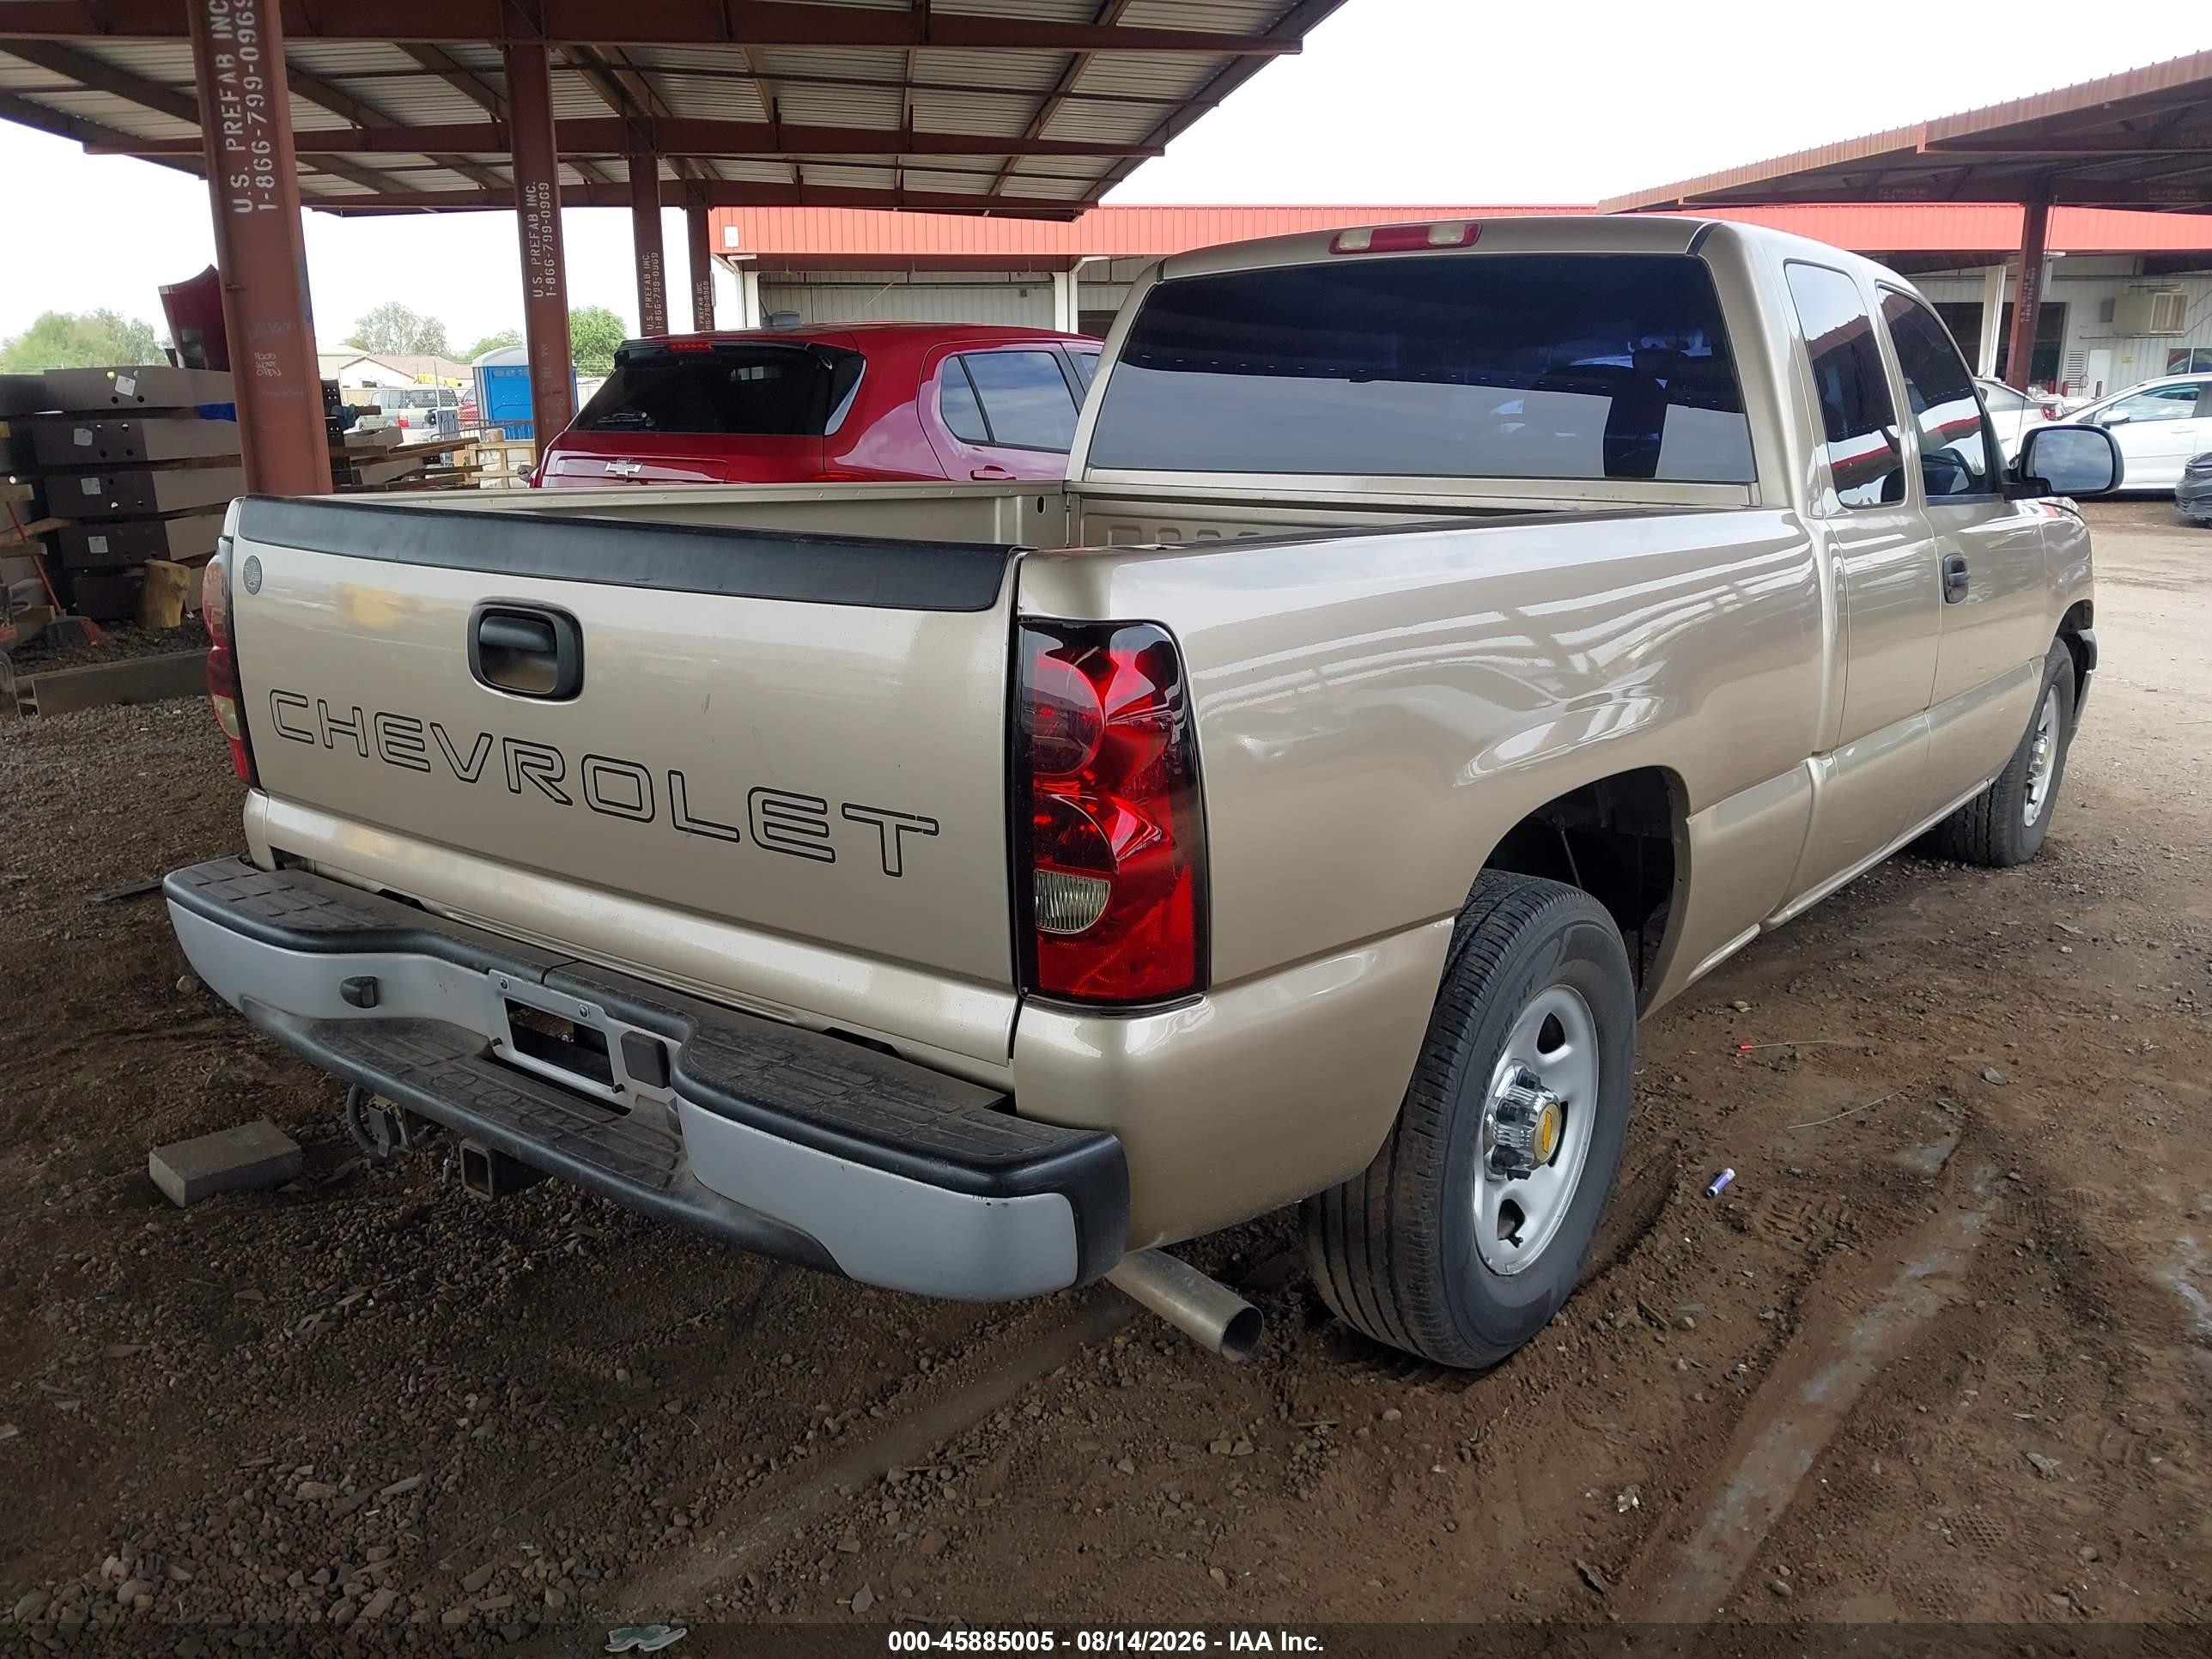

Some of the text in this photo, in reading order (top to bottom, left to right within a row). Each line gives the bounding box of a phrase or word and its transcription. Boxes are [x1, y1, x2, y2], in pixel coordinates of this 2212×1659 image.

[216, 53, 246, 151] PREFAB
[230, 167, 252, 213] U.S.
[526, 181, 544, 298] U.S. PREFAB INC.
[538, 182, 557, 296] 1-866-799-0969
[643, 273, 653, 308] PREFAB
[268, 688, 941, 879] CHEVROLET
